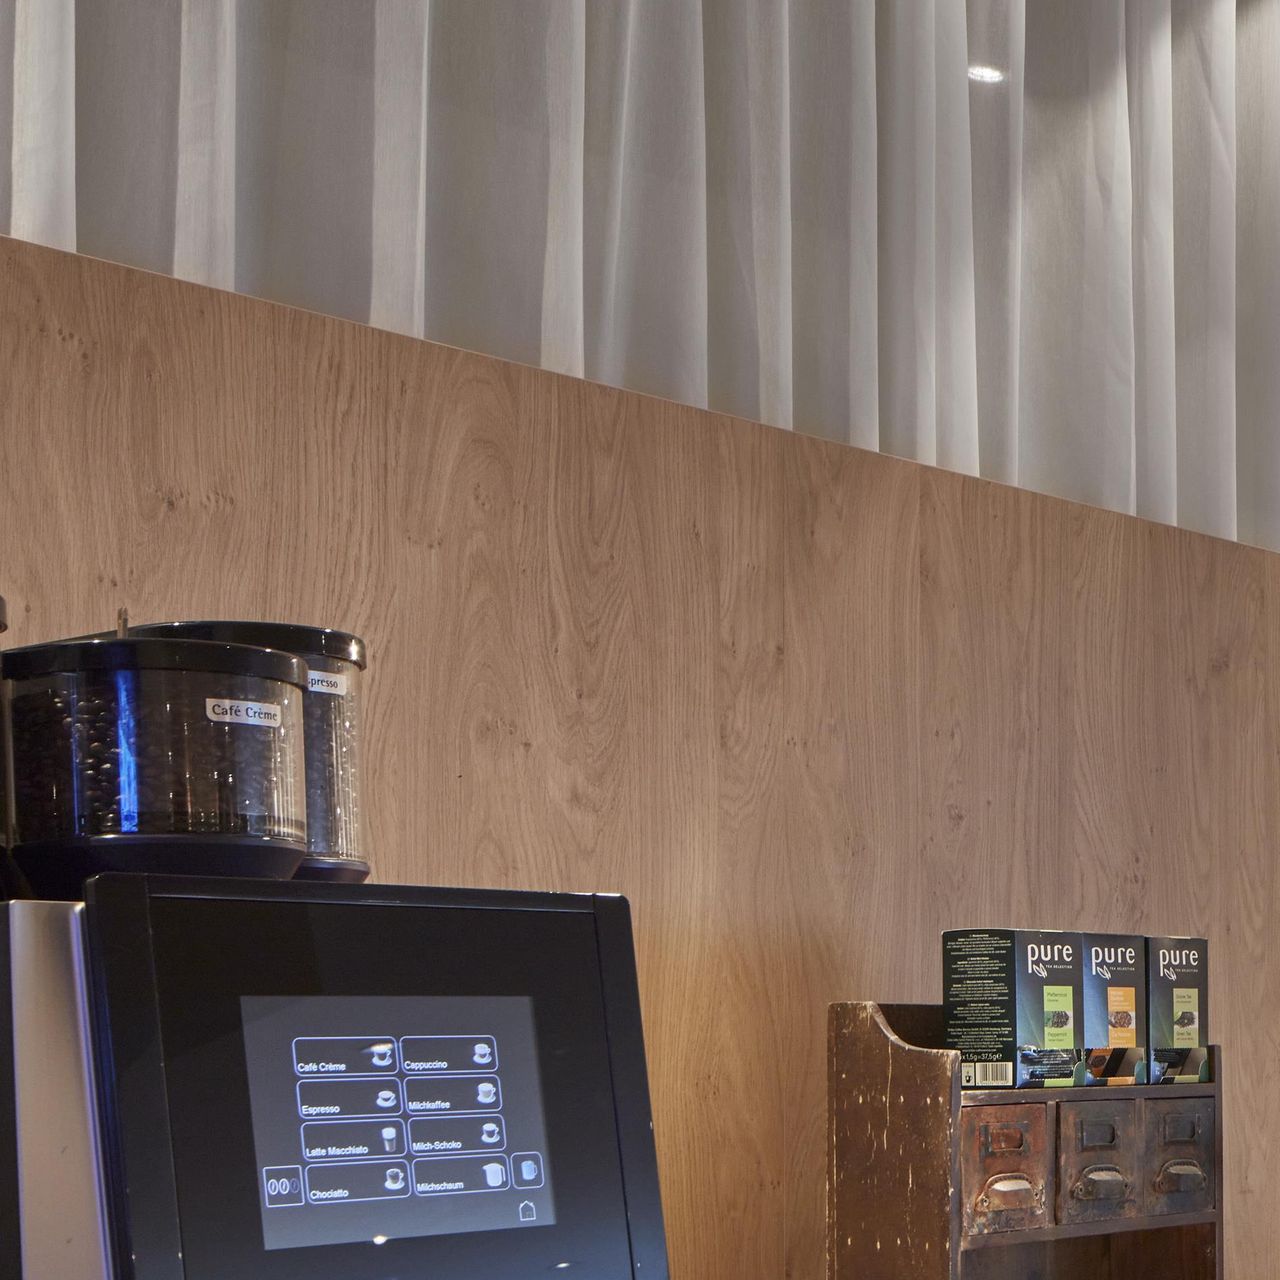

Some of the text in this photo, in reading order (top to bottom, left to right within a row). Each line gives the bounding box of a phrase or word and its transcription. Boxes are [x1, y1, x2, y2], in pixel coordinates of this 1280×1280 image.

[308, 677, 338, 688] presso
[212, 704, 278, 721] Café Crème
[1027, 943, 1073, 974] pure
[1091, 946, 1136, 975] pure
[1159, 949, 1198, 977] pure
[297, 1061, 347, 1073] Café Crème
[404, 1060, 448, 1071] Cappuccino
[301, 1104, 340, 1116] Espresso
[408, 1100, 450, 1110] Milchkaffee
[306, 1144, 369, 1157] Latte Macchiato
[412, 1140, 462, 1151] Milch-Schoko
[416, 1181, 464, 1193] Milchschaum
